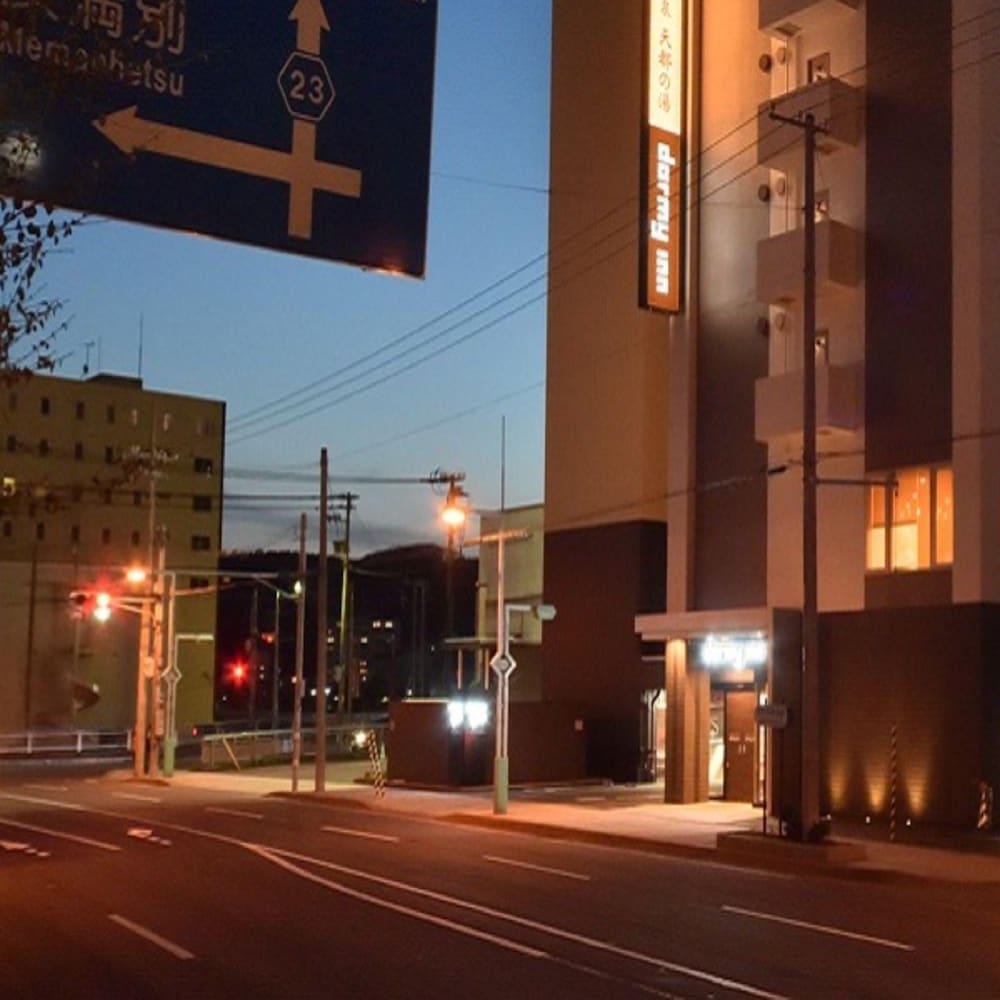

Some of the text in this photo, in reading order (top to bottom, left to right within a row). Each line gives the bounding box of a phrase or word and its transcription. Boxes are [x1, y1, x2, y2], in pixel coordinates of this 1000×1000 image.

[289, 67, 326, 105] 23
[651, 142, 677, 295] dormy inn
